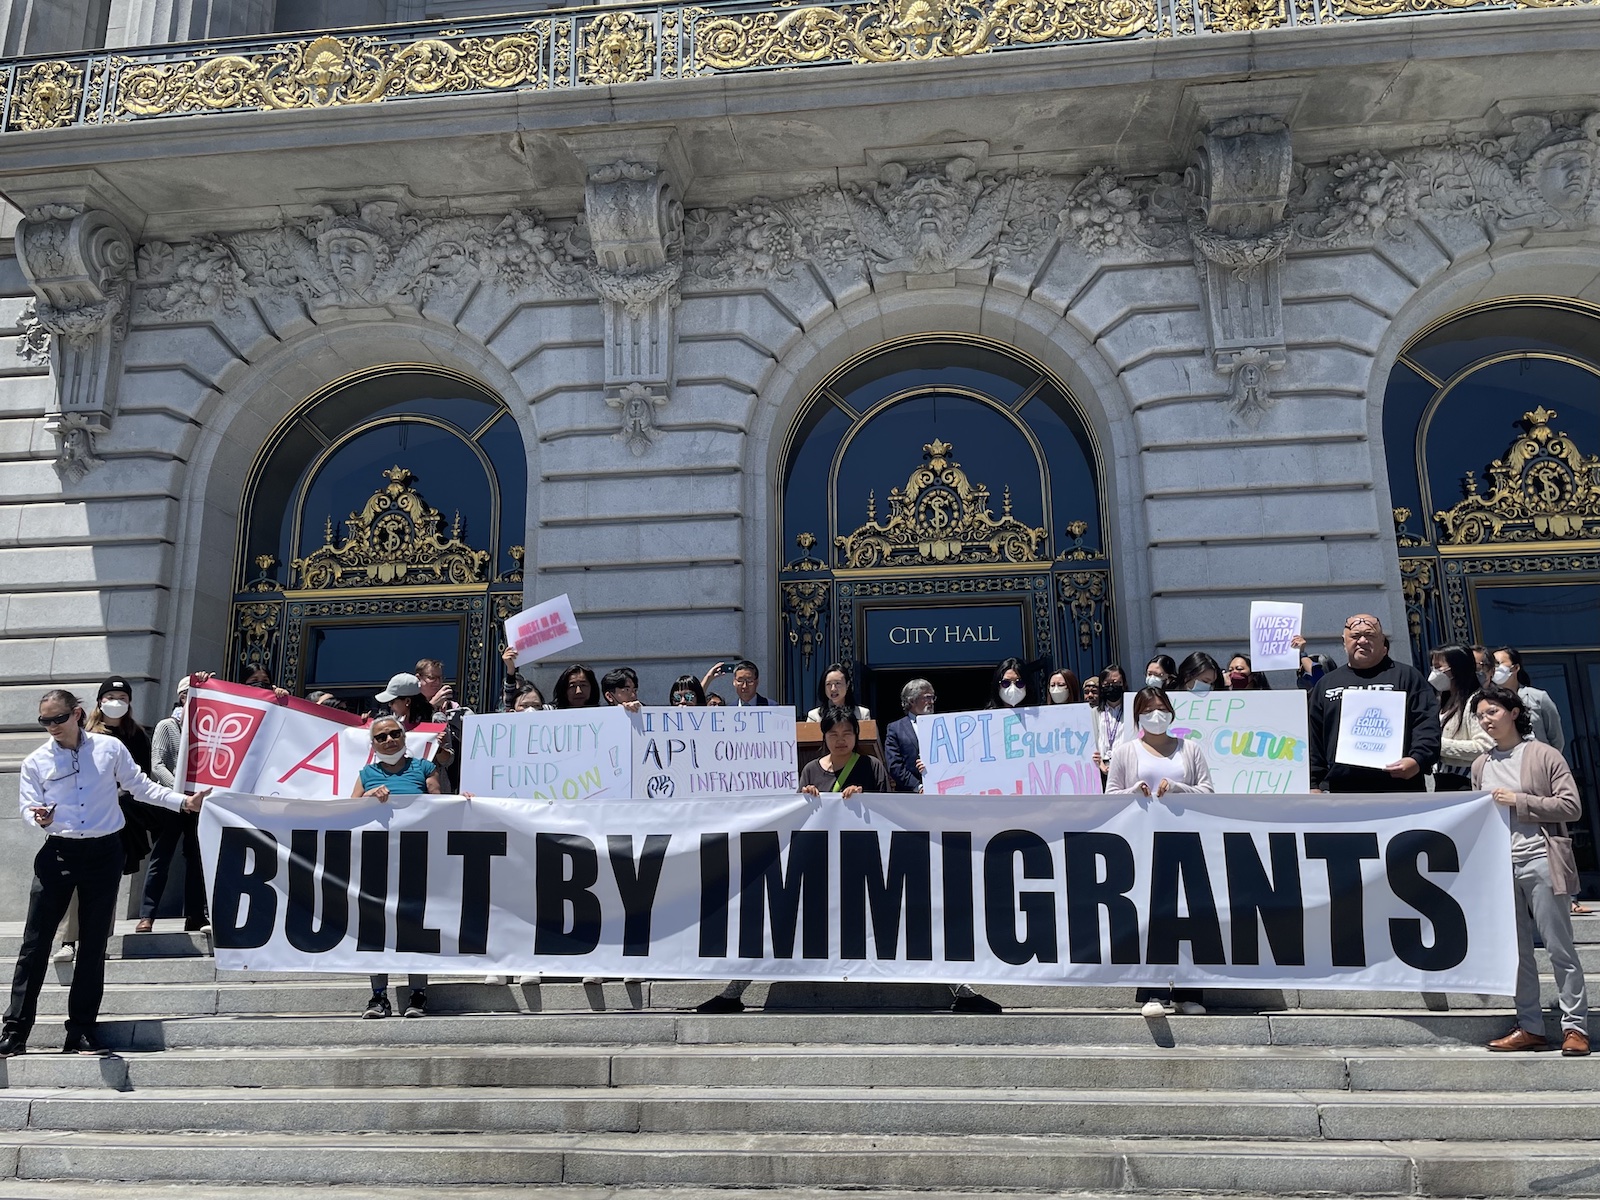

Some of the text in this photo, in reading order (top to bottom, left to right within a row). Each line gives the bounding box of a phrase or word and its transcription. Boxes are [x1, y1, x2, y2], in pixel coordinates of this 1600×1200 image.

[1256, 616, 1297, 628] INVEST
[889, 625, 1000, 645] CITY HALL
[1259, 629, 1293, 641] IN API
[1261, 641, 1290, 655] ART!
[643, 711, 772, 734] INVEST
[1356, 718, 1389, 728] EQUITY
[1364, 709, 1381, 718] API
[470, 721, 604, 760] API EQUITY
[929, 713, 996, 765] API
[1002, 713, 1091, 760] Equity
[1352, 727, 1392, 737] FUNDING
[642, 738, 796, 770] API COMMUNITY
[1213, 729, 1307, 762] CULTURE
[1355, 742, 1385, 751] NOW!!!
[491, 763, 559, 790] FUND
[689, 771, 798, 793] INFRASTRUCTURE
[211, 826, 1468, 971] BUILT BY IMMIGRANTS
